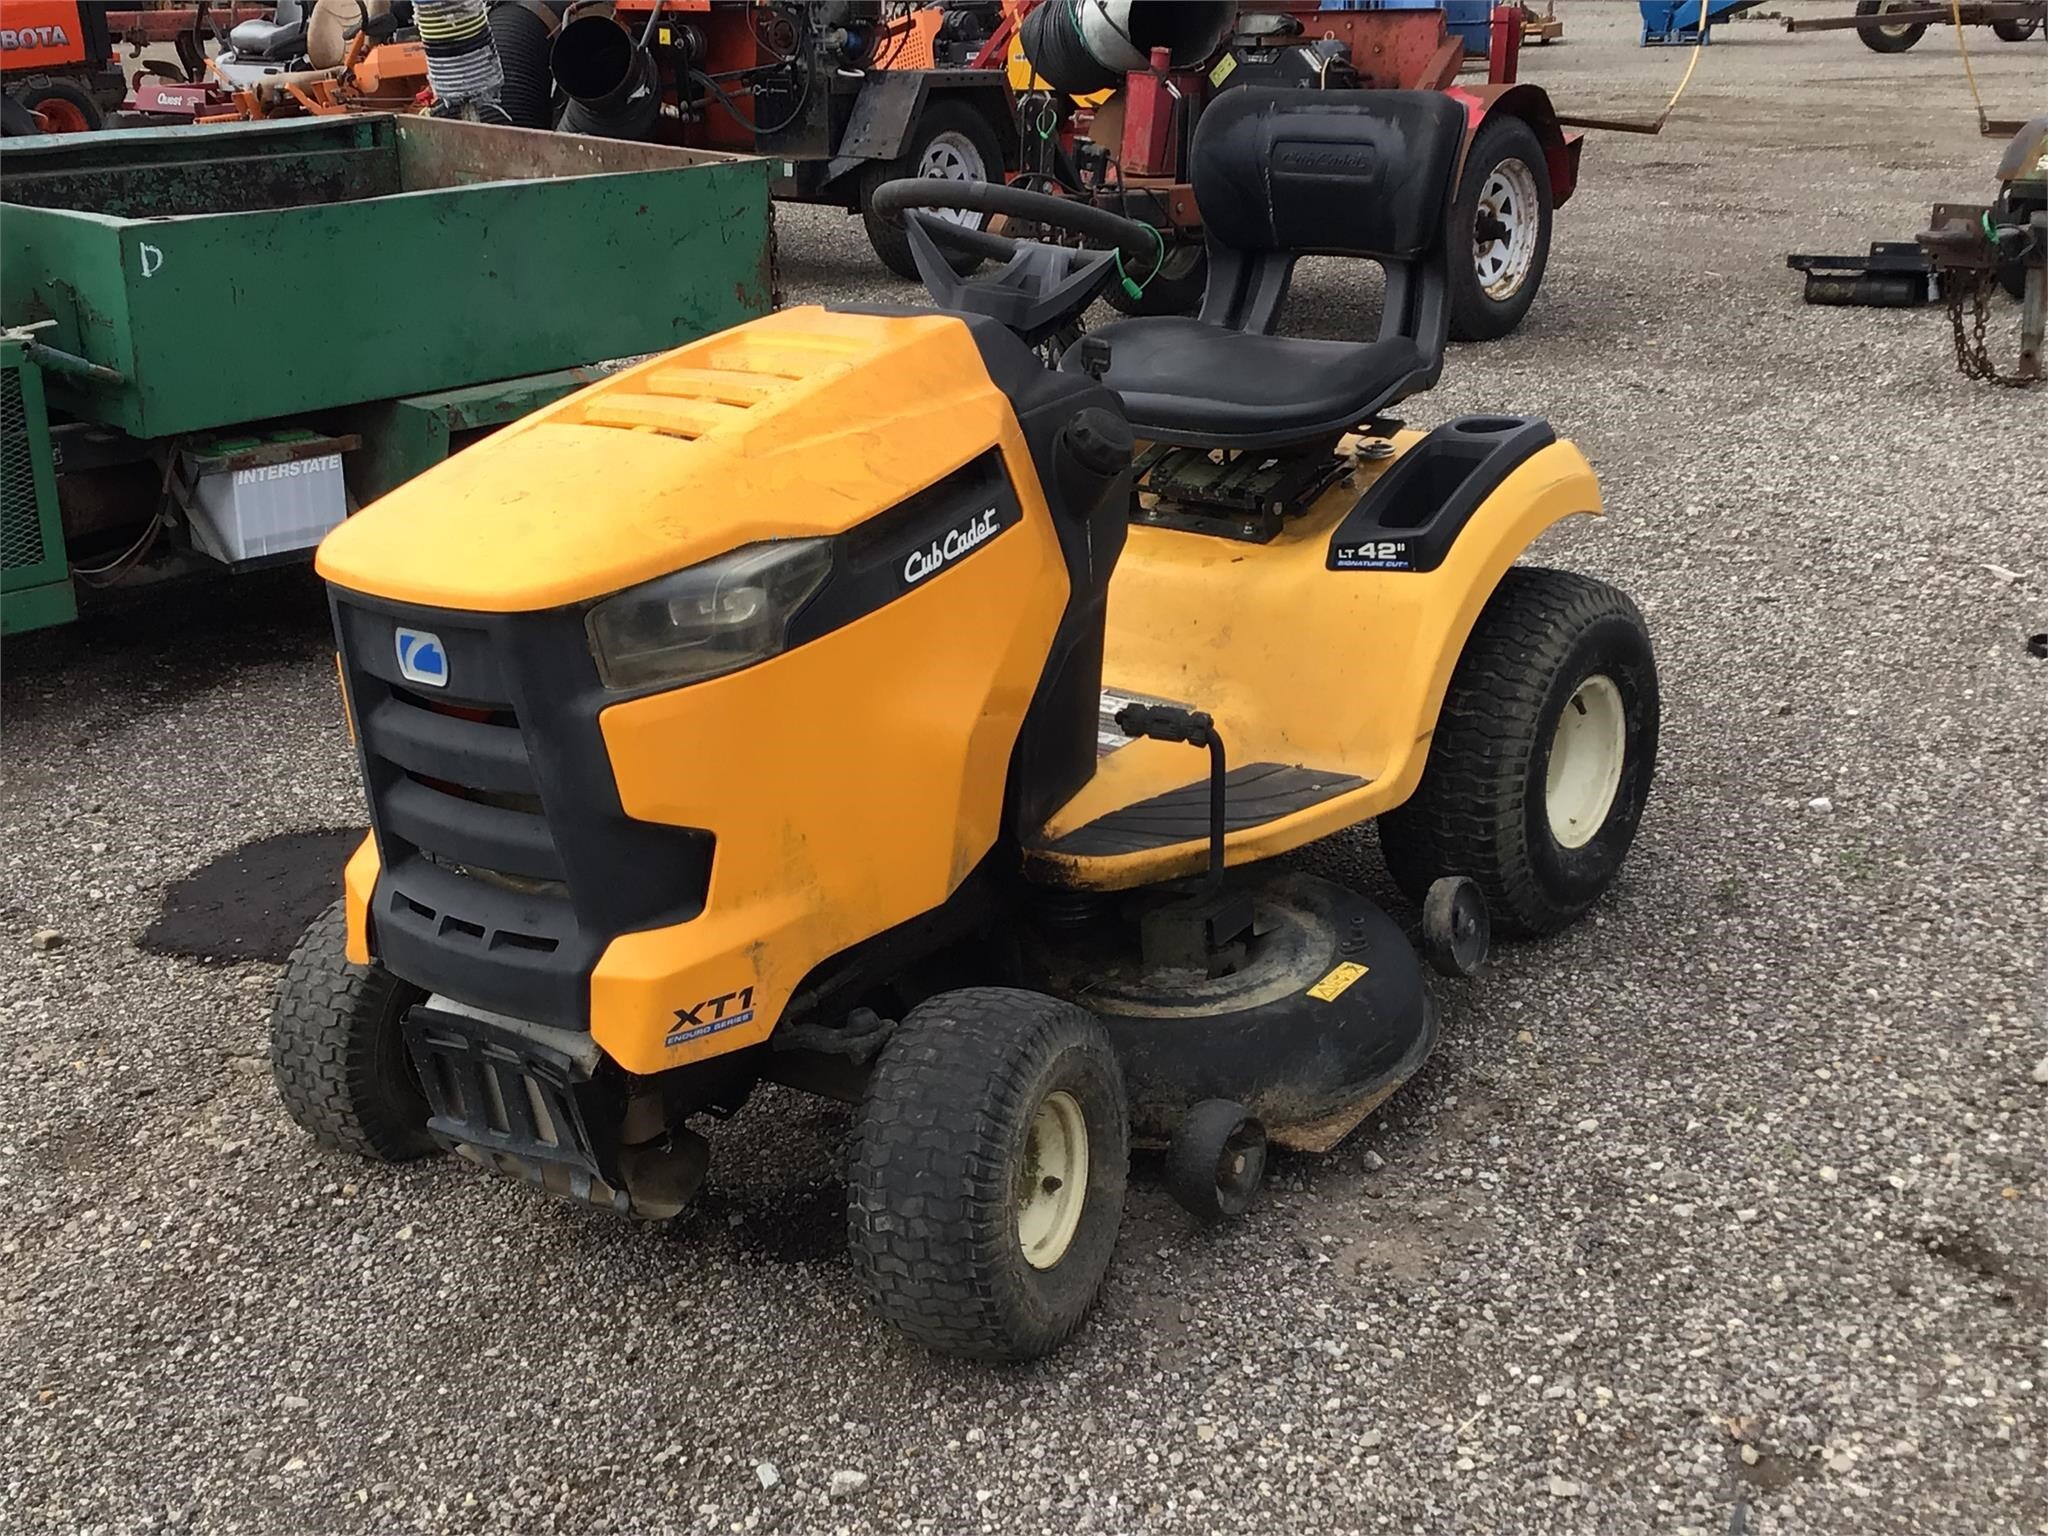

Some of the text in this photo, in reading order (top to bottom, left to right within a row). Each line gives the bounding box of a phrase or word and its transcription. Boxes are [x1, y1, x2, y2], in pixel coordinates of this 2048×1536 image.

[157, 92, 183, 106] Quest
[140, 241, 164, 278] D
[238, 454, 341, 485] INTERSTATE
[904, 508, 997, 583] Cub Cadet
[1338, 542, 1405, 560] LT 42"
[667, 986, 754, 1034] XT1
[667, 1012, 750, 1045] ENDURO SERIES
